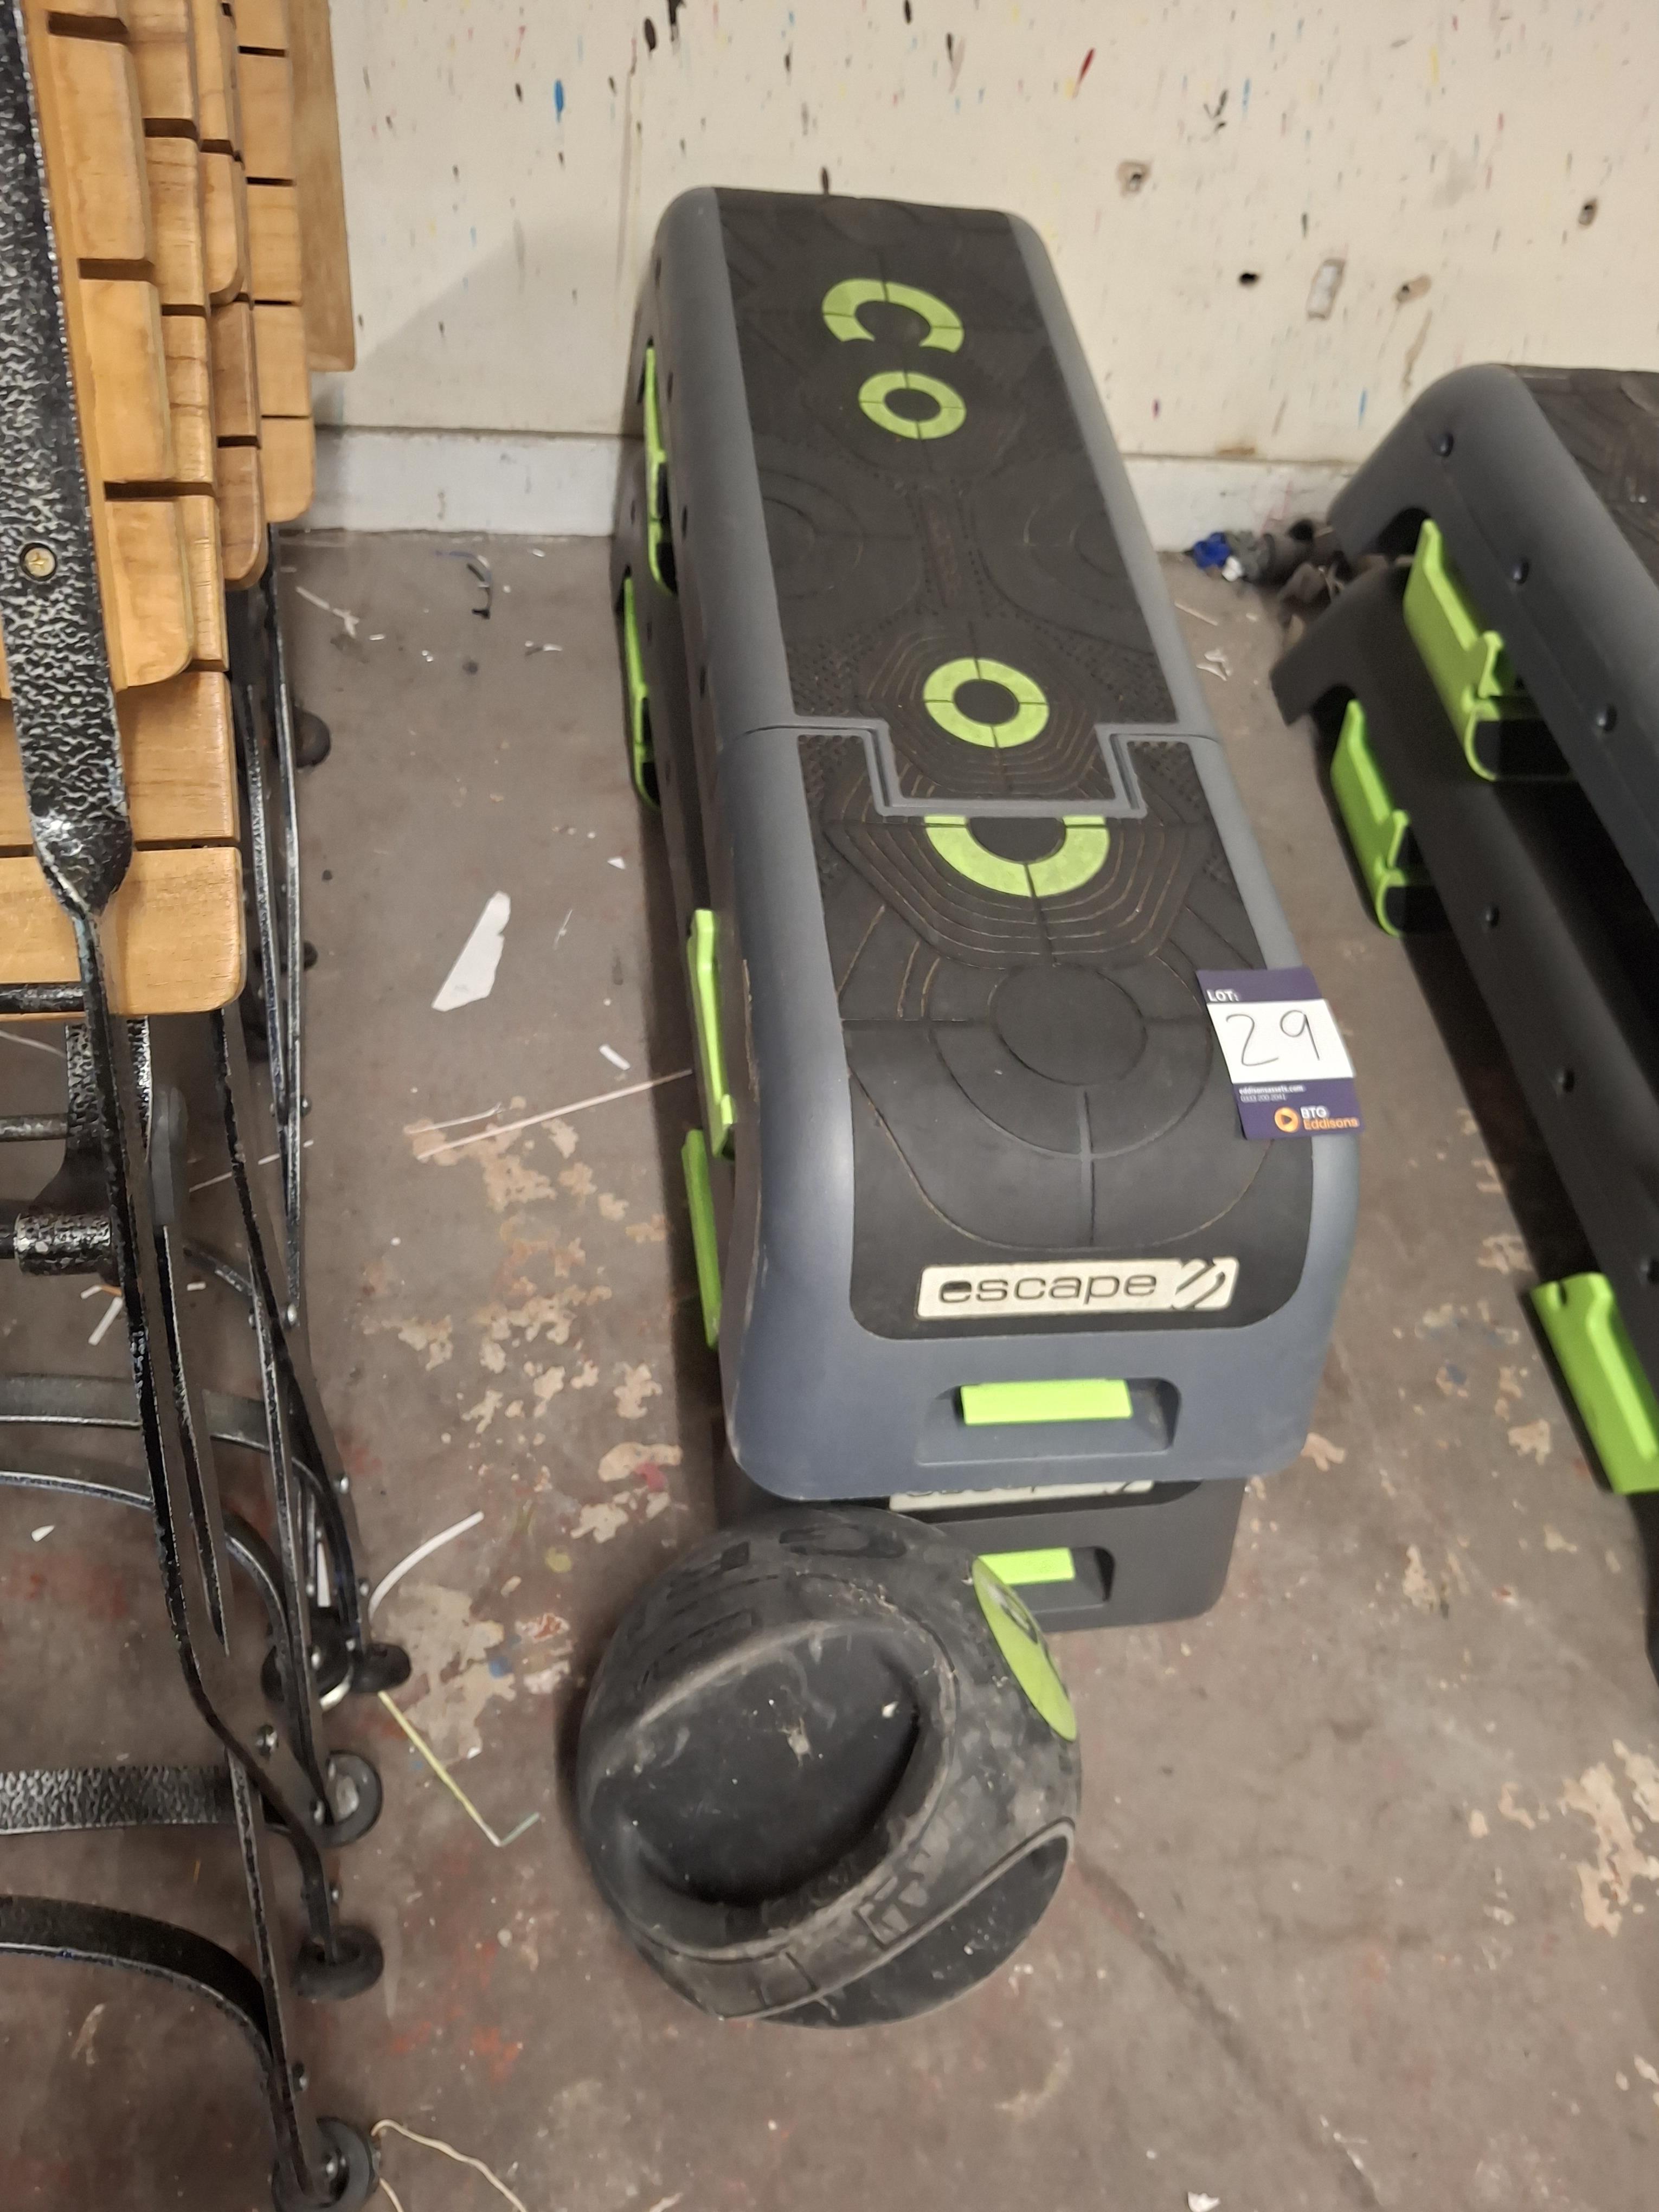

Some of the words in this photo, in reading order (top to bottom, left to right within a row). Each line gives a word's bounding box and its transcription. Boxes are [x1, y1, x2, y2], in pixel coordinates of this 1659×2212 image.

[1207, 989, 1239, 1002] LOT:
[1226, 1009, 1320, 1066] 29
[1238, 1085, 1305, 1095] eddisonsassets.com
[1301, 1106, 1328, 1118] BTG
[1303, 1118, 1360, 1130] Eddisons
[938, 1274, 1158, 1304] escape
